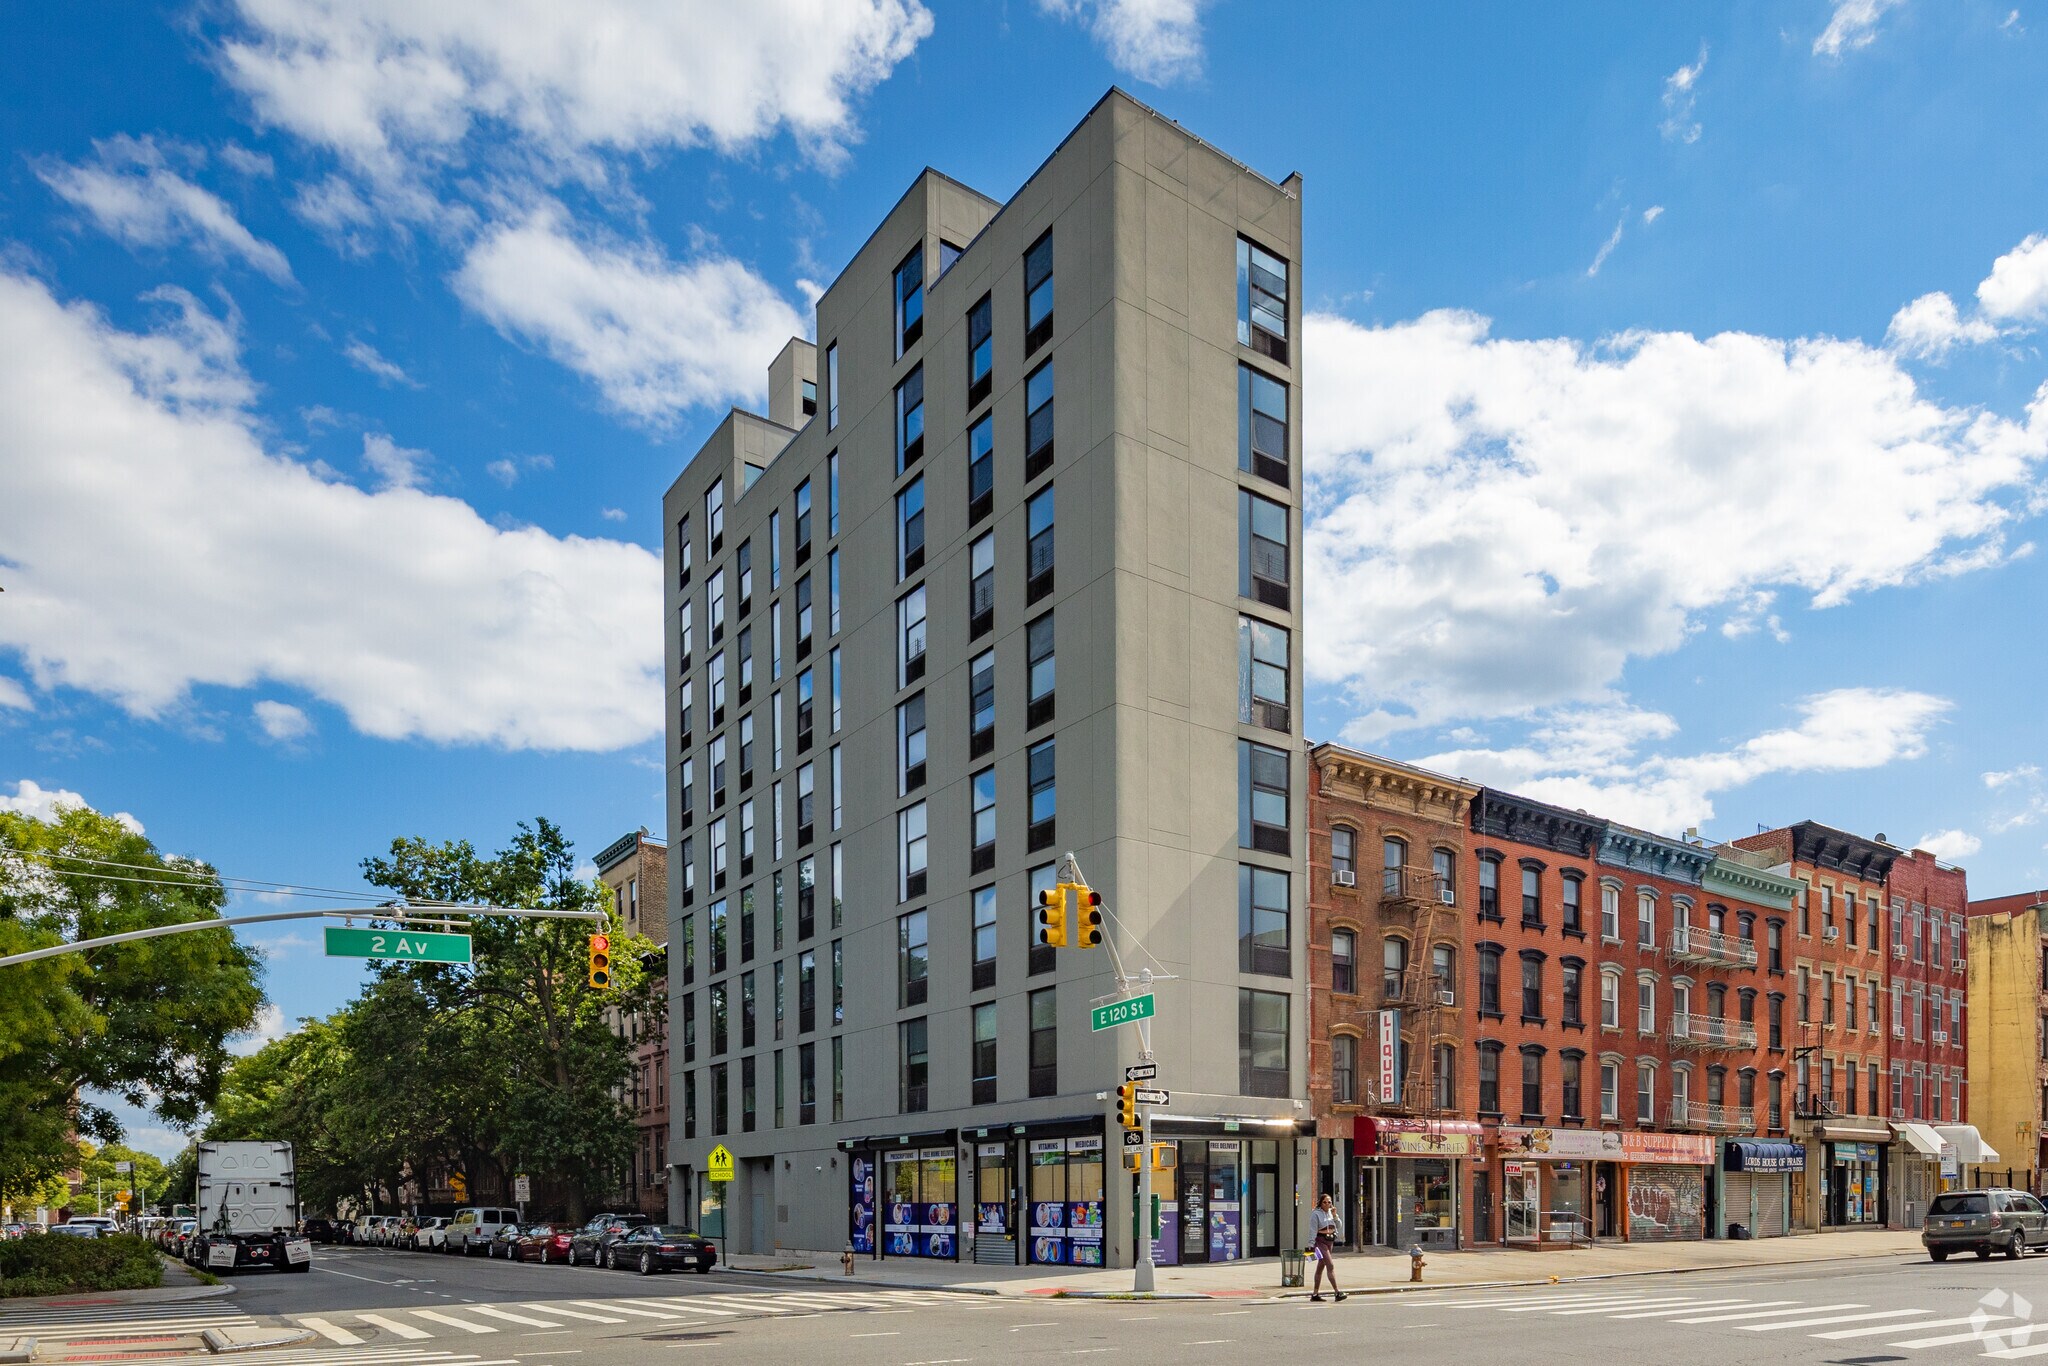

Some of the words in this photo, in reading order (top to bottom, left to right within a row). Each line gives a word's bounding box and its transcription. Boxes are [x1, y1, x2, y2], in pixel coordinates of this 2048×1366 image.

[371, 936, 386, 953] 2
[395, 937, 428, 955] Av
[1100, 1011, 1107, 1025] E
[1109, 1005, 1128, 1022] 120
[1130, 1001, 1144, 1017] St
[1383, 1015, 1393, 1099] LIQUOR
[1129, 1070, 1139, 1078] ONE
[1142, 1068, 1153, 1077] WAY
[1038, 1142, 1058, 1150] VITAMINS
[1074, 1139, 1098, 1149] MEDICARE
[1623, 1134, 1628, 1147] B
[1629, 1135, 1635, 1147] &
[1636, 1135, 1641, 1147] B
[1643, 1135, 1672, 1148] SUPPLY
[1745, 1156, 1760, 1166] LORDS
[1762, 1157, 1777, 1167] HOUSE
[1778, 1157, 1786, 1166] OF
[1787, 1156, 1803, 1166] PRAISE
[1505, 1165, 1521, 1173] ATM
[711, 1171, 732, 1179] SCHOOL
